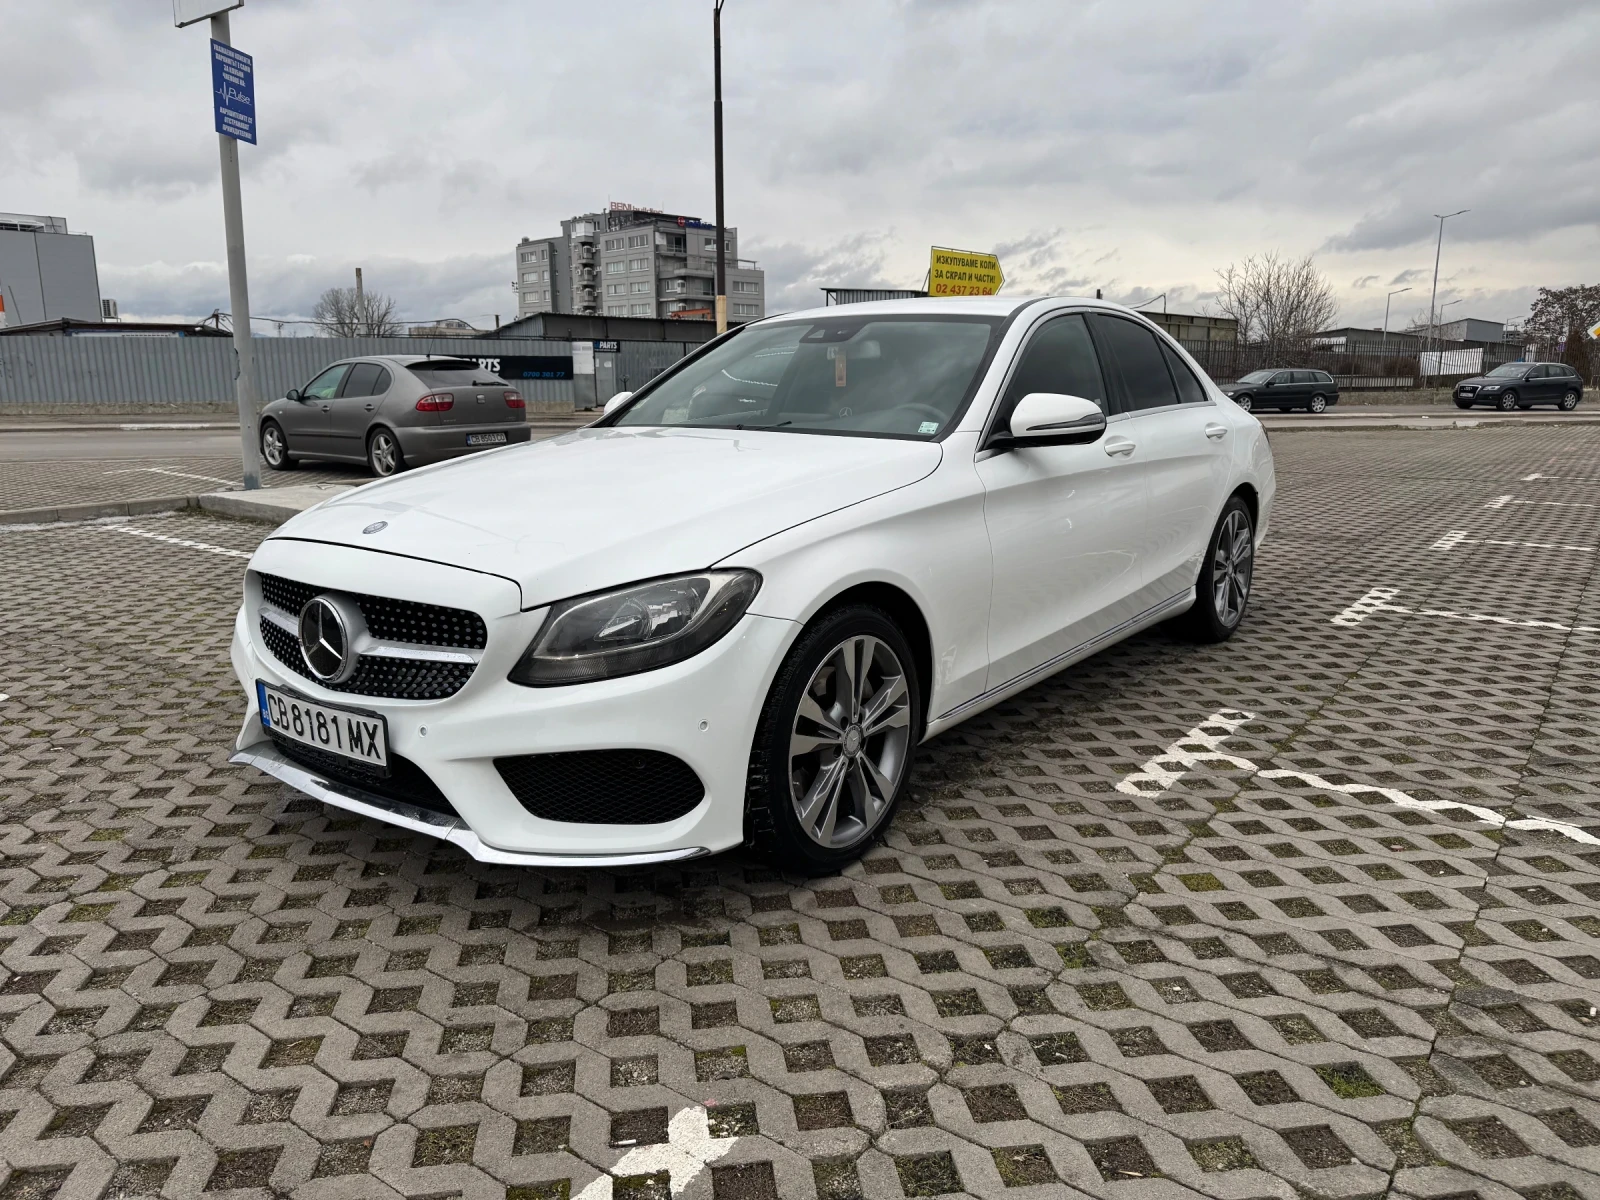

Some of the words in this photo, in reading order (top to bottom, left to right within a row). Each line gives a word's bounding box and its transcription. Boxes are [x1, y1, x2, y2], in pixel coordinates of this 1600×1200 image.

[228, 86, 251, 105] Pulse
[610, 201, 632, 211] BENI
[936, 255, 979, 268] ИЗКУПУВАМЕ
[979, 260, 996, 270] КОЛИ
[934, 269, 944, 279] ЗА
[945, 270, 967, 281] СКРАП
[967, 273, 973, 282] И
[974, 274, 996, 284] ЧАСТИ!
[935, 283, 948, 294] 02
[950, 285, 967, 295] 437
[969, 286, 980, 296] 23
[982, 287, 993, 296] 64
[267, 693, 290, 731] CB
[290, 703, 342, 749] 8181
[347, 717, 382, 760] MX
